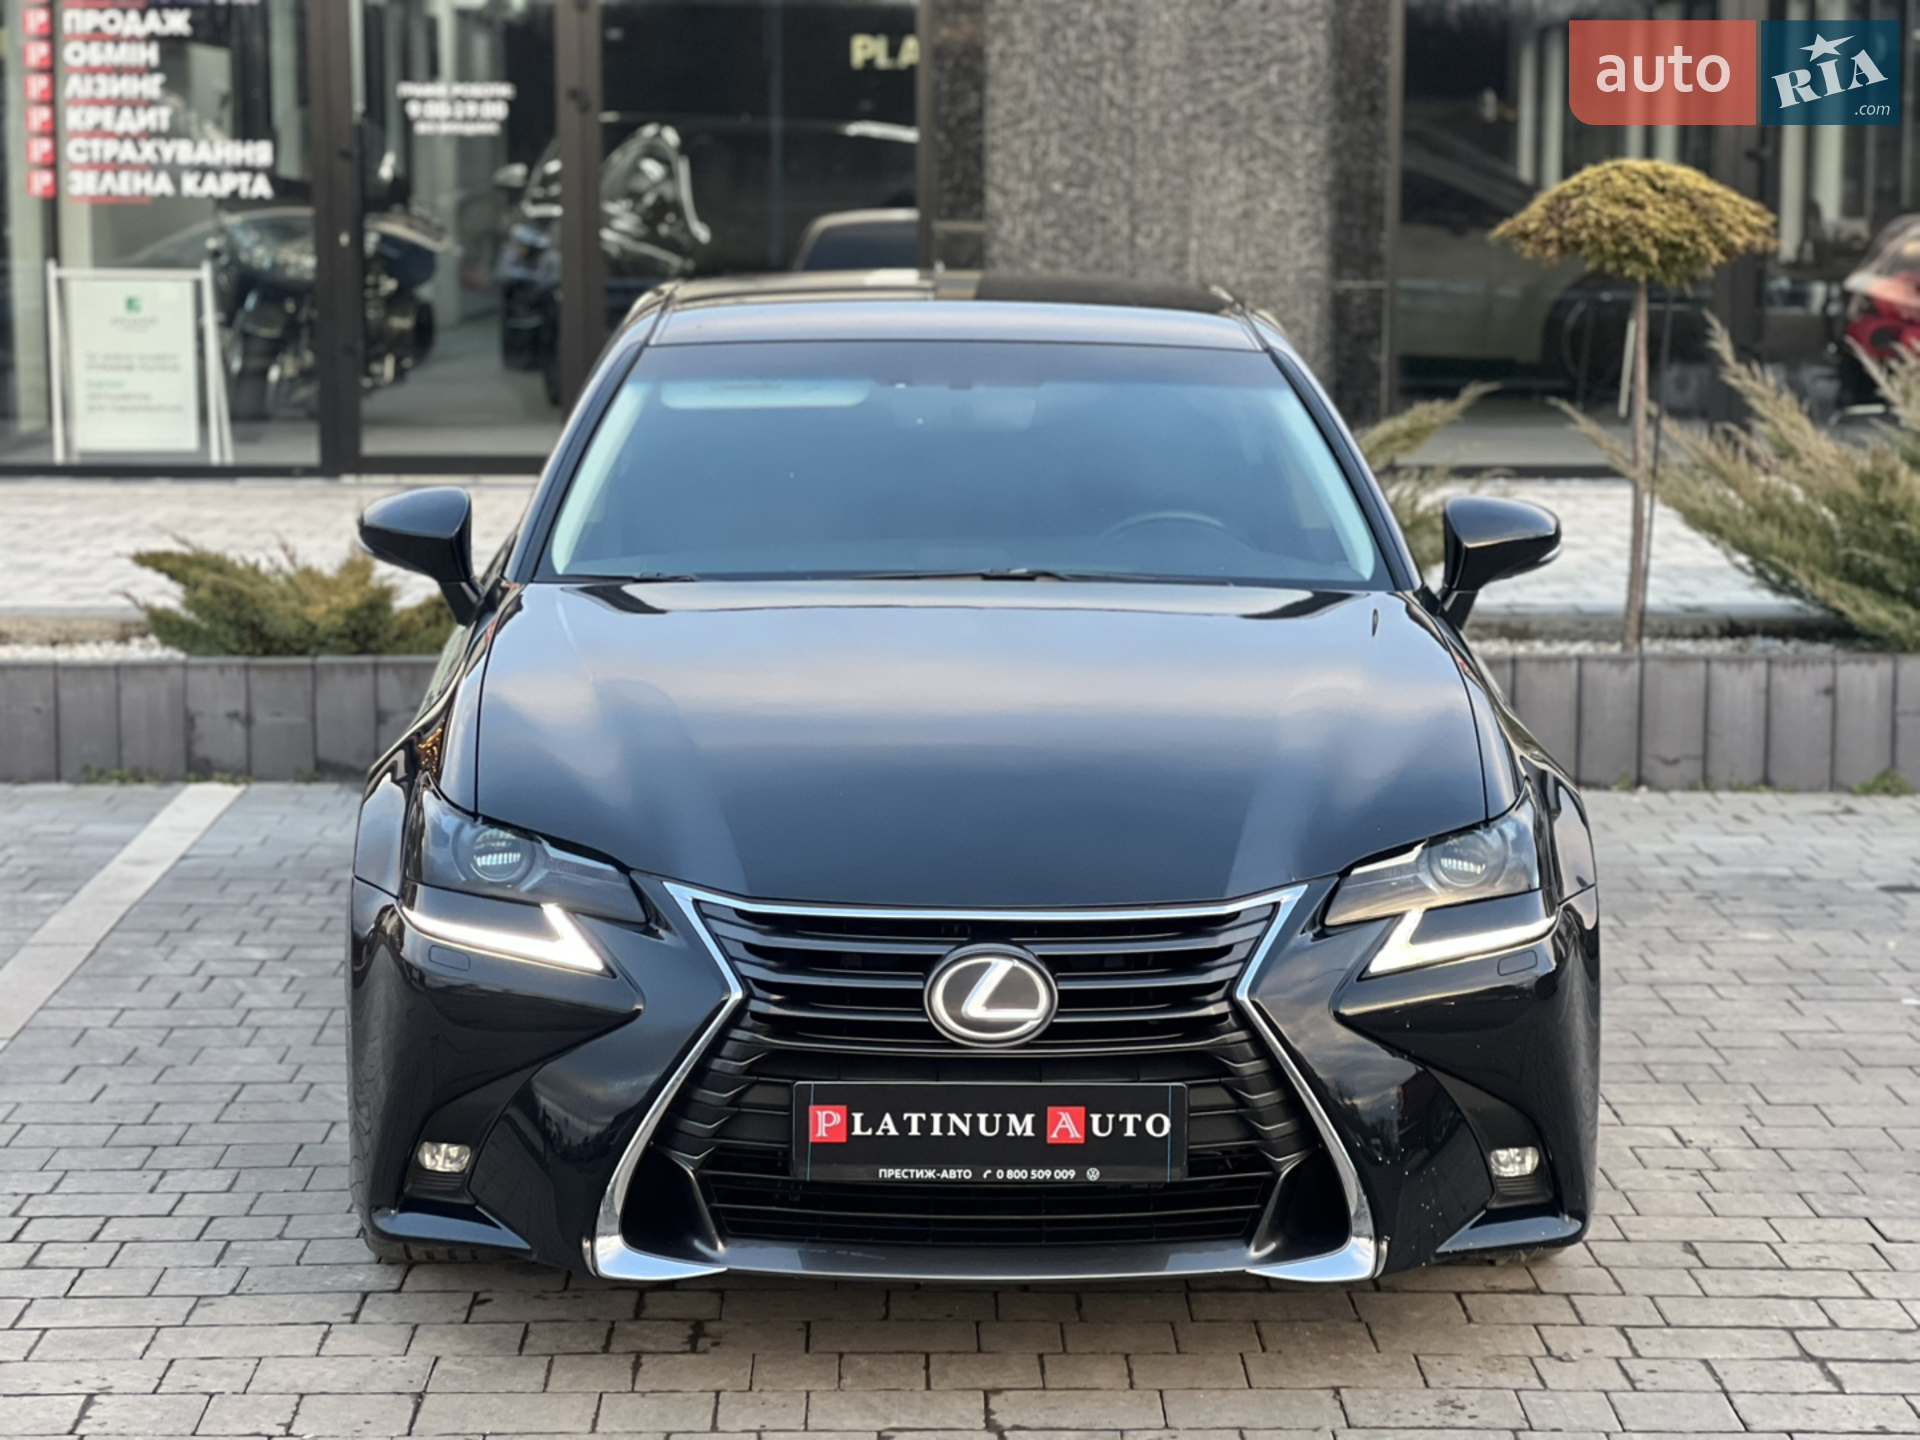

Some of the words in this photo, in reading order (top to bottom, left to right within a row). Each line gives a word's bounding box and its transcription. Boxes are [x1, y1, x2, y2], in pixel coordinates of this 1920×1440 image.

[62, 8, 192, 37] ПРОДАЖ
[63, 41, 160, 67] ОБМІН
[64, 73, 166, 100] ЛІЗИНГ
[66, 105, 173, 134] КРЕДИТ
[66, 138, 274, 167] СТРАХУВАННЯ
[67, 170, 175, 197] ЗЕЛЕНА
[181, 172, 274, 199] КАРТА
[812, 1108, 1035, 1138] PLATINUM
[1049, 1111, 1171, 1139] AUTO
[878, 1168, 972, 1179] ПРЕСТИЖ-АВТО
[996, 1169, 1005, 1180] 0
[1006, 1169, 1028, 1180] 800
[1030, 1169, 1051, 1180] 509
[1054, 1169, 1076, 1180] 009
